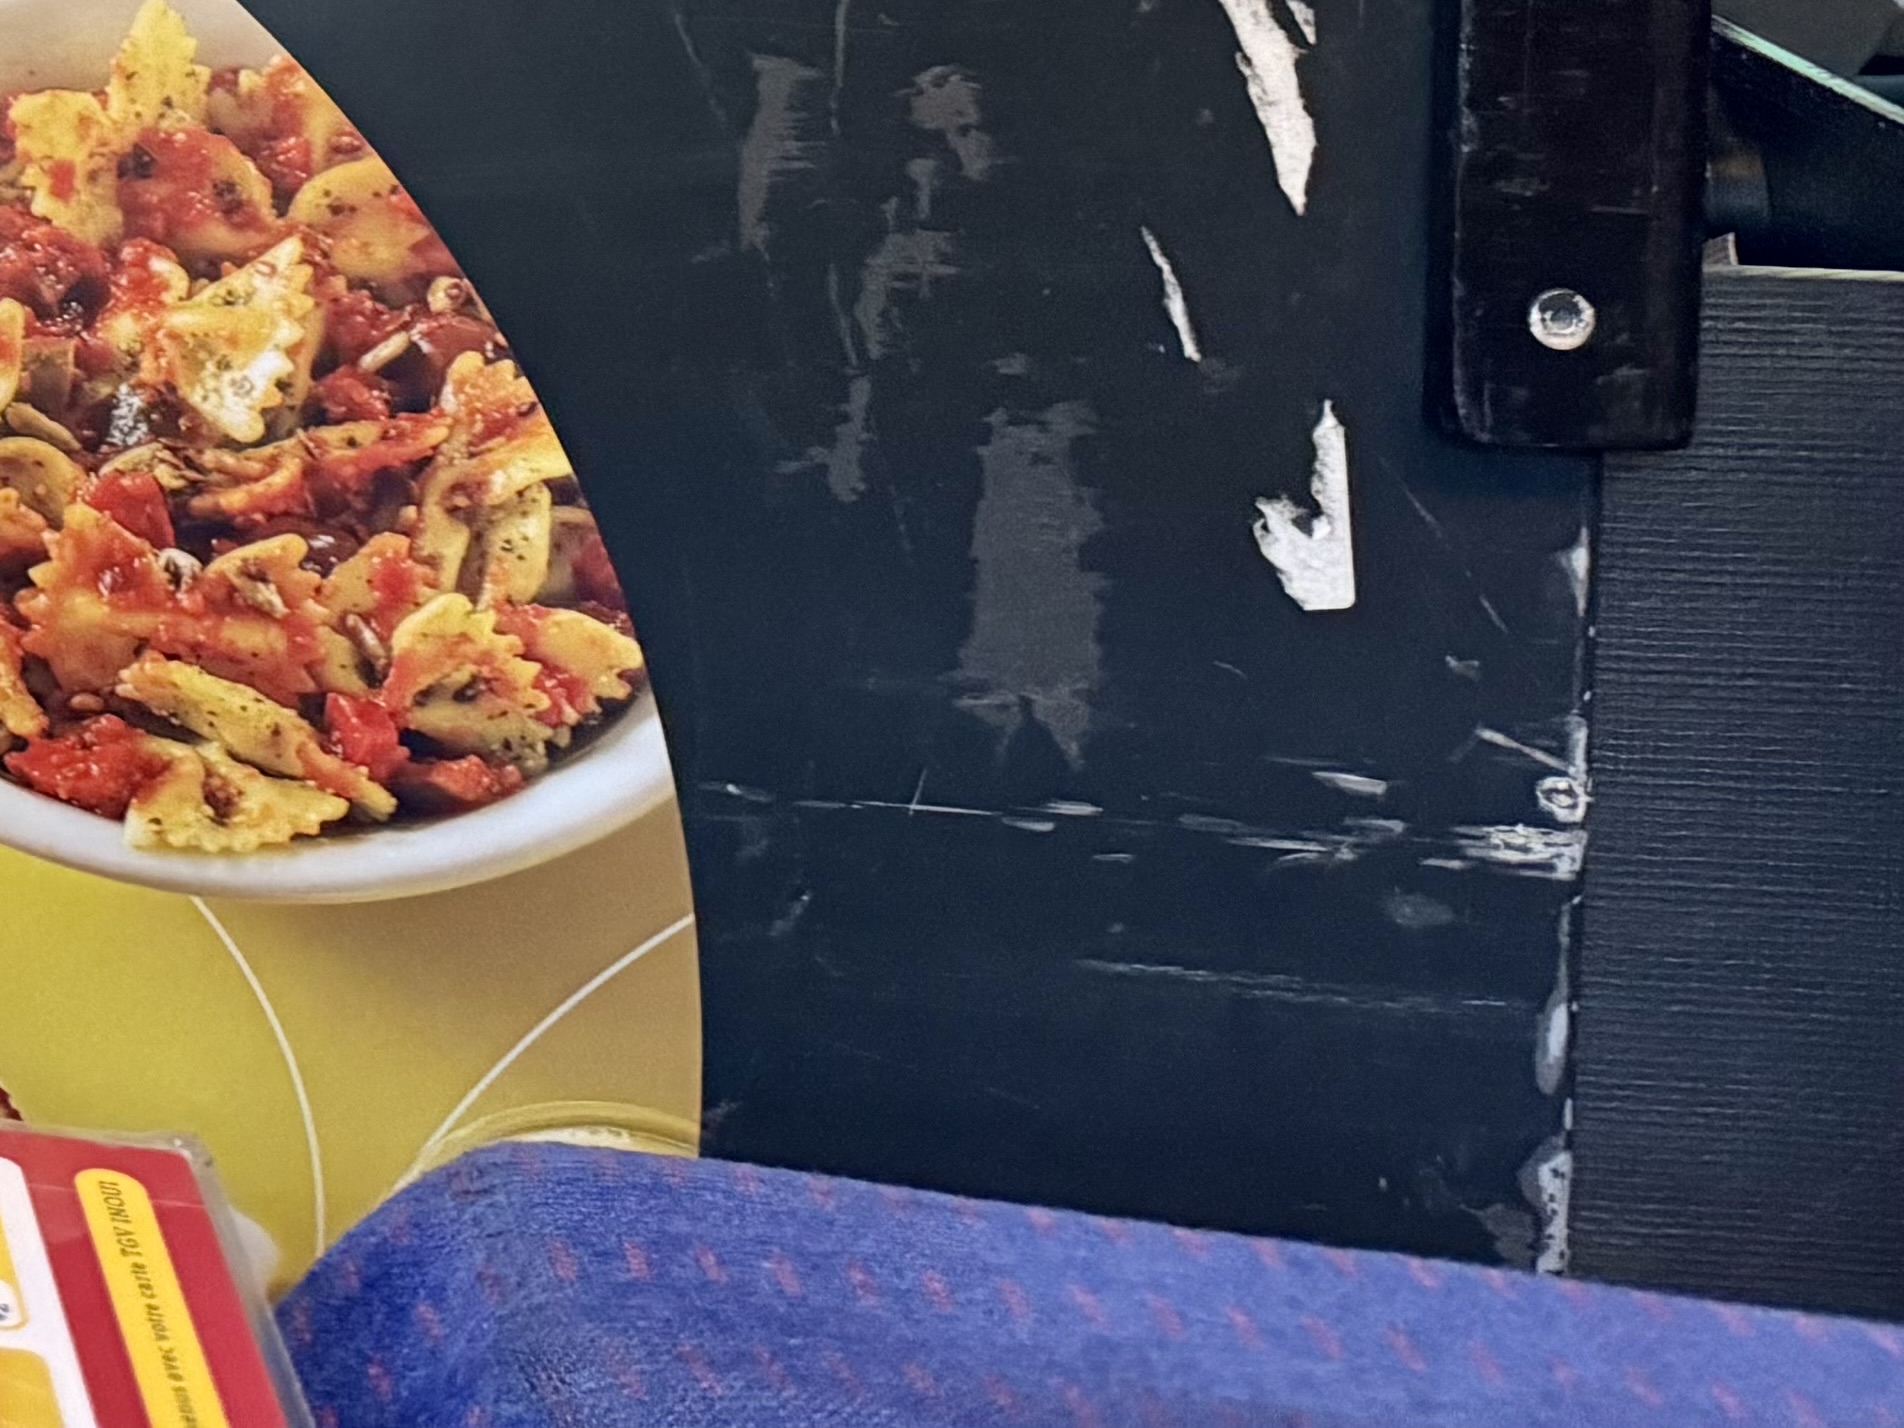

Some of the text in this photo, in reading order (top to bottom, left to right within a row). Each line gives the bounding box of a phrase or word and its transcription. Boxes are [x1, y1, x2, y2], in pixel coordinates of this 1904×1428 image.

[97, 1179, 133, 1225] INOUI
[112, 1225, 144, 1259] TGV
[130, 1261, 159, 1301] carte
